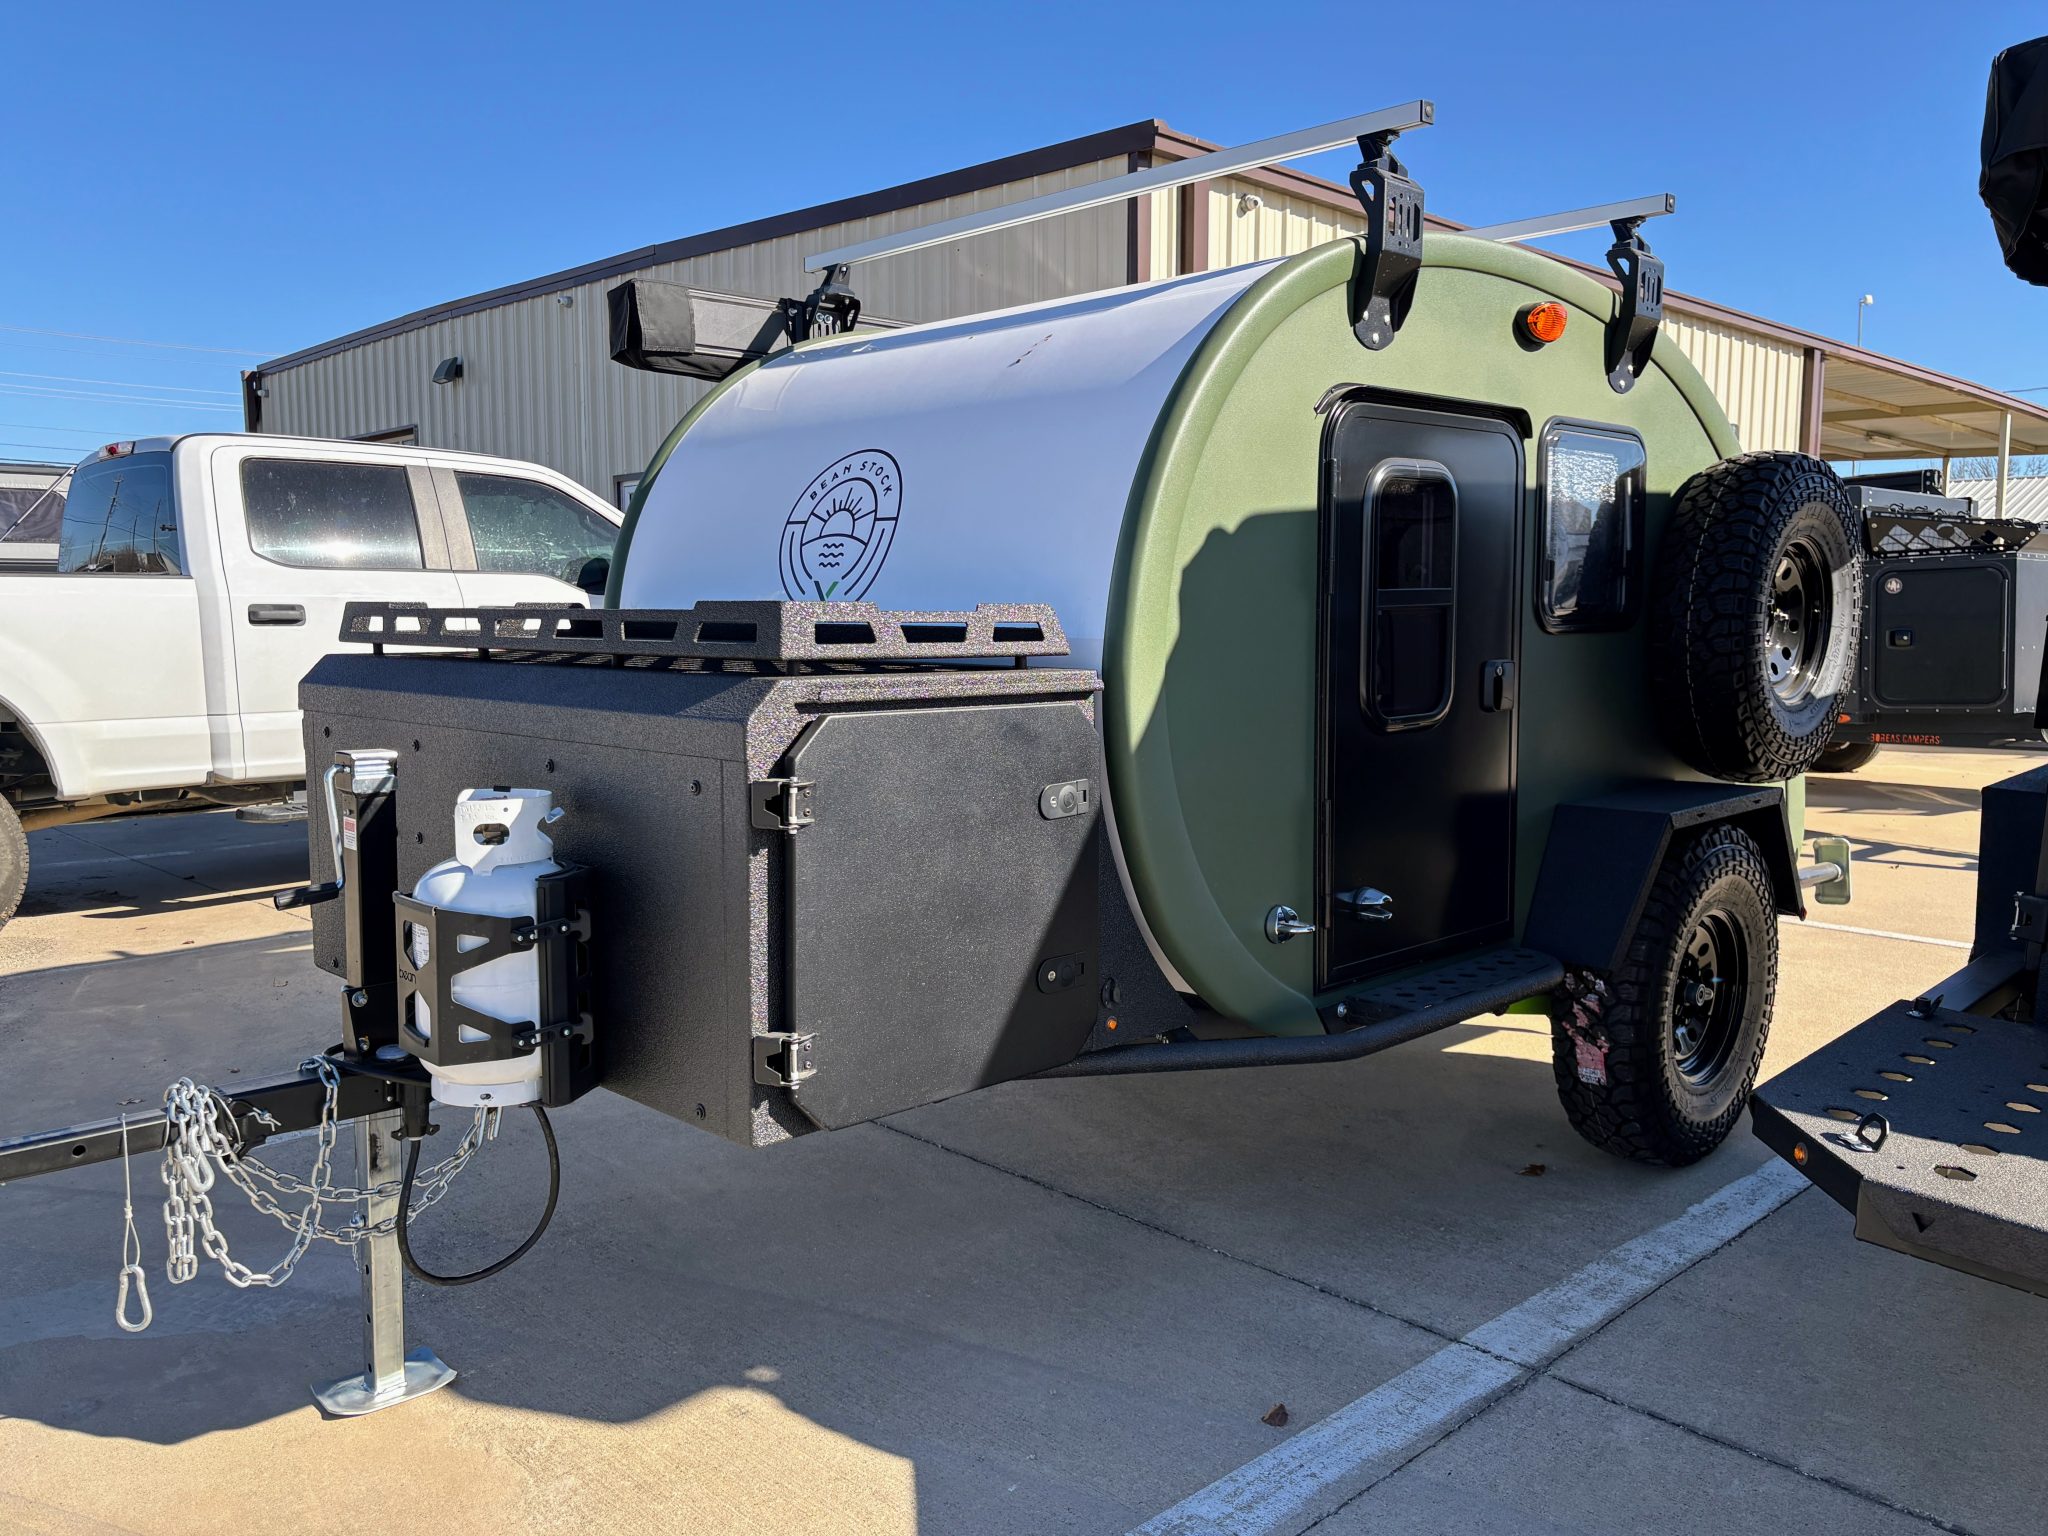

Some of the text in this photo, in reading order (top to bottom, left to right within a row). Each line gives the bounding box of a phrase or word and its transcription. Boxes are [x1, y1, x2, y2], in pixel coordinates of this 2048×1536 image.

[809, 460, 893, 501] BEAN STOCK
[1871, 733, 1940, 745] BOREAS CAMPERS
